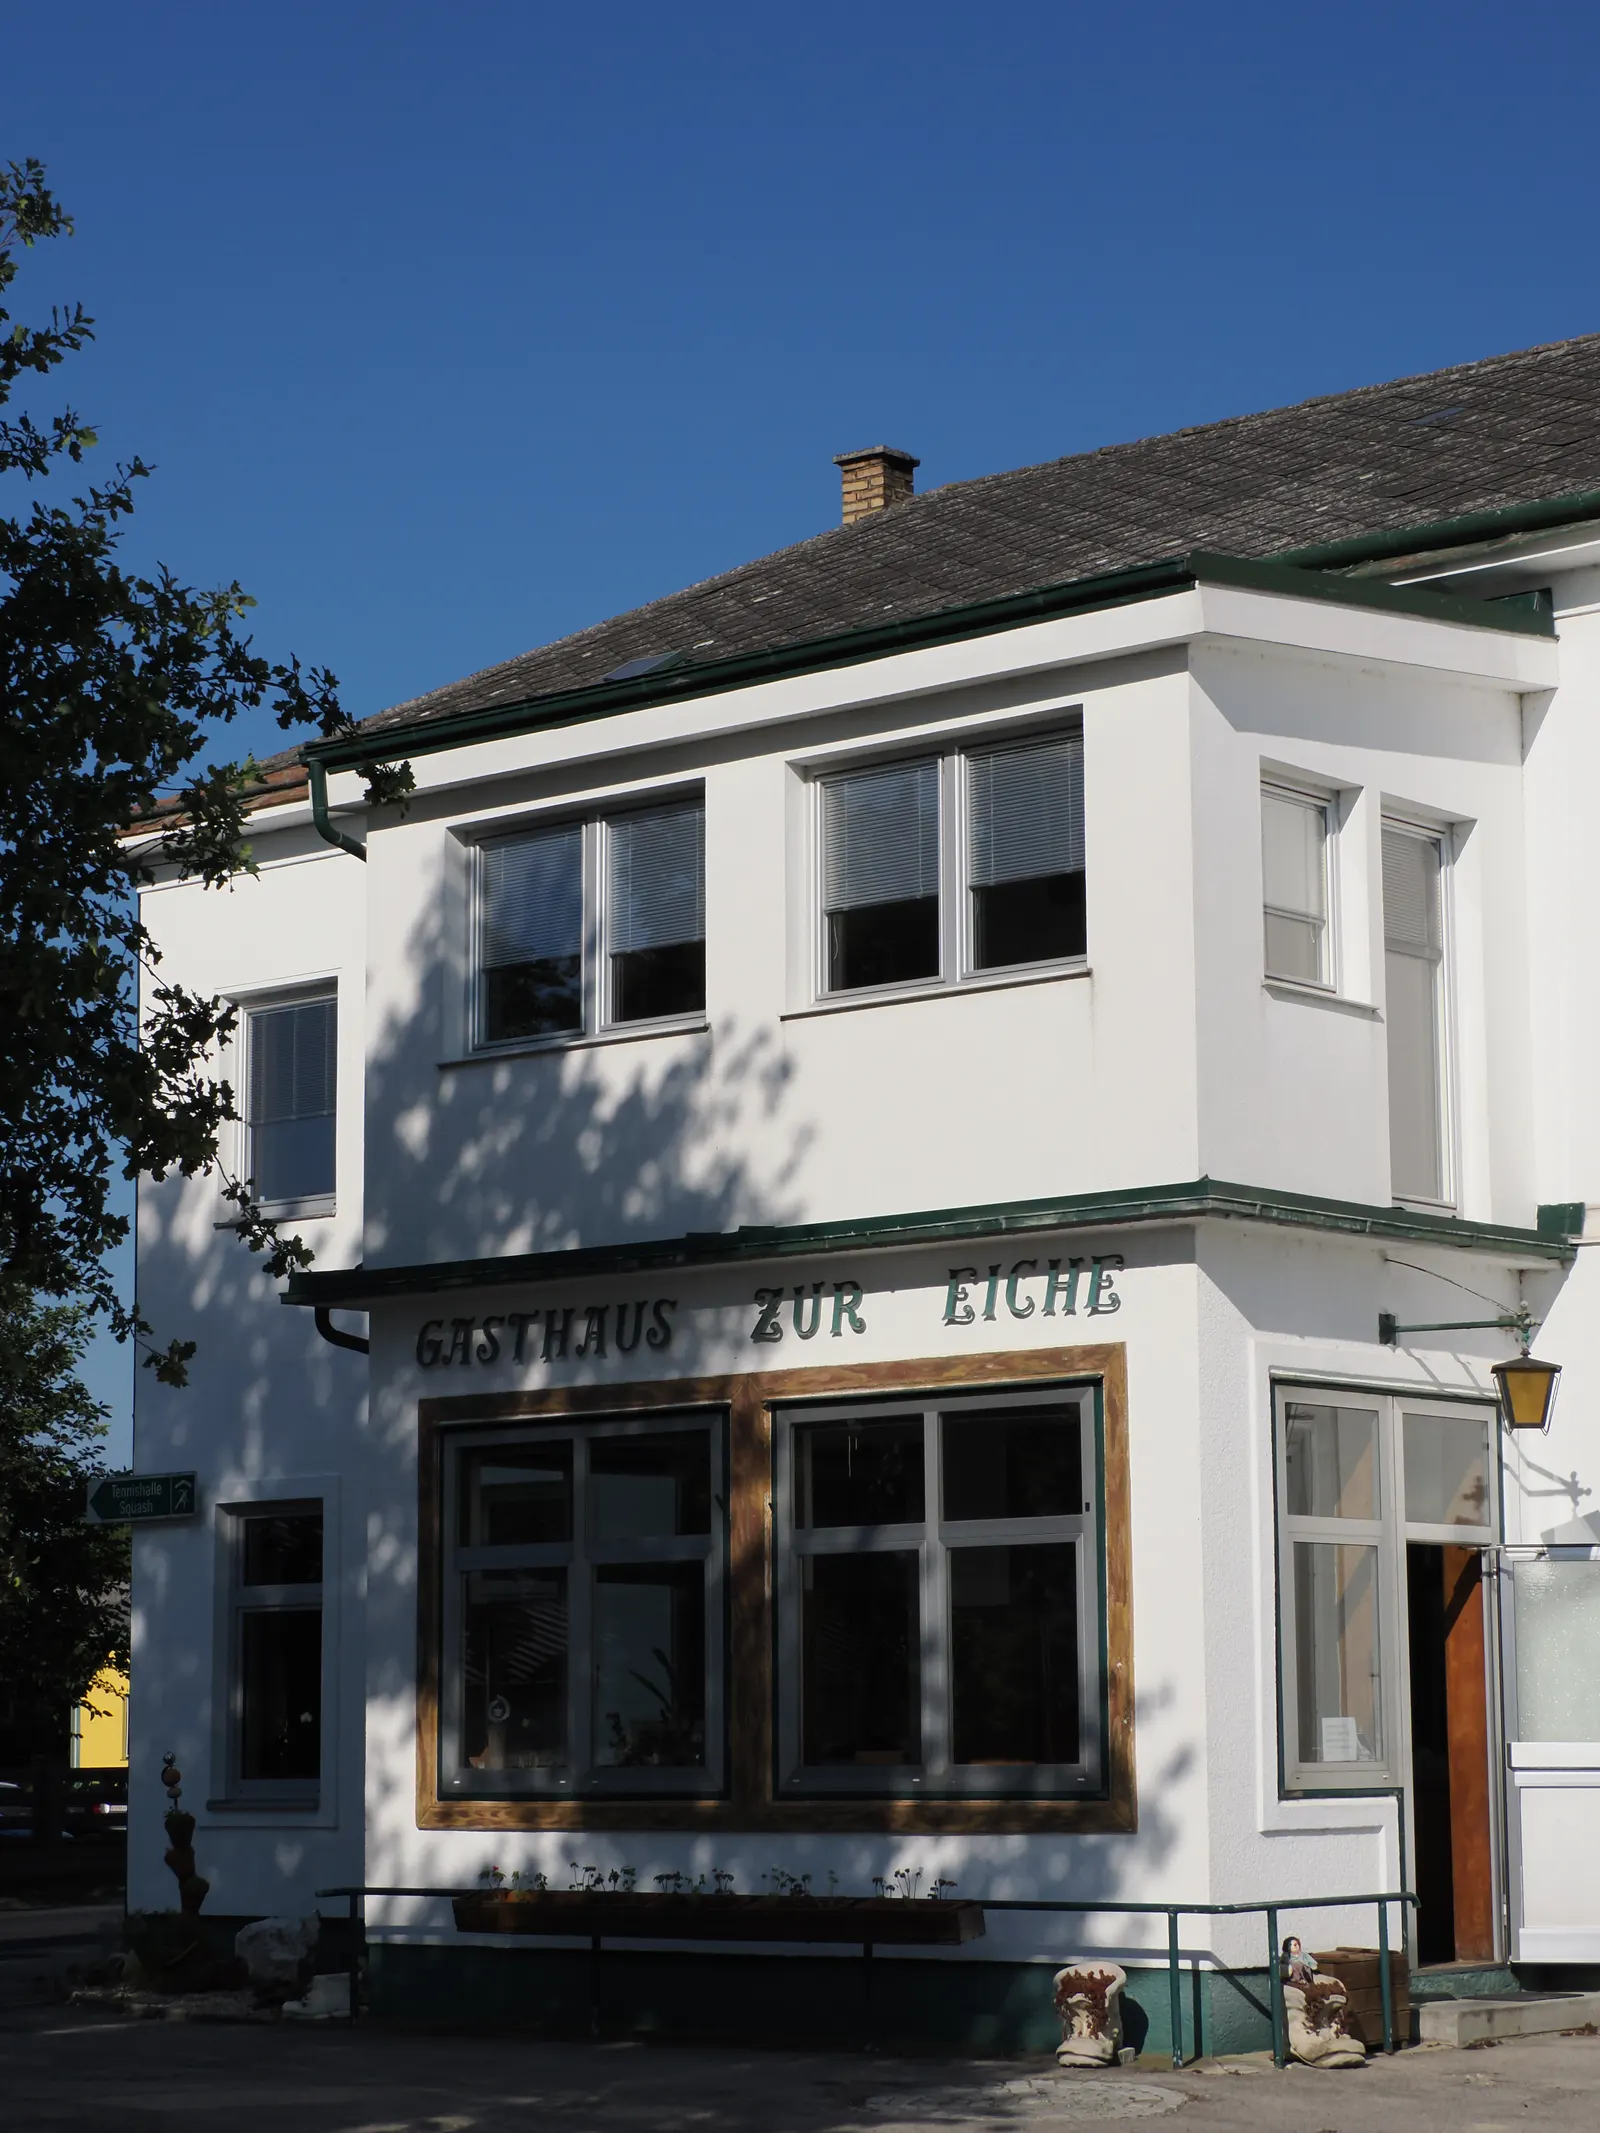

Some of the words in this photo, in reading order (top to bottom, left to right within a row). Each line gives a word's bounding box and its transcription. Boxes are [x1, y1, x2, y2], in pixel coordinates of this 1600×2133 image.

[416, 1298, 678, 1368] GASTHAUS
[750, 1280, 867, 1343] ZUR
[942, 1253, 1124, 1327] EICHE
[111, 1482, 162, 1498] Tennishalle
[119, 1499, 154, 1517] Squash
